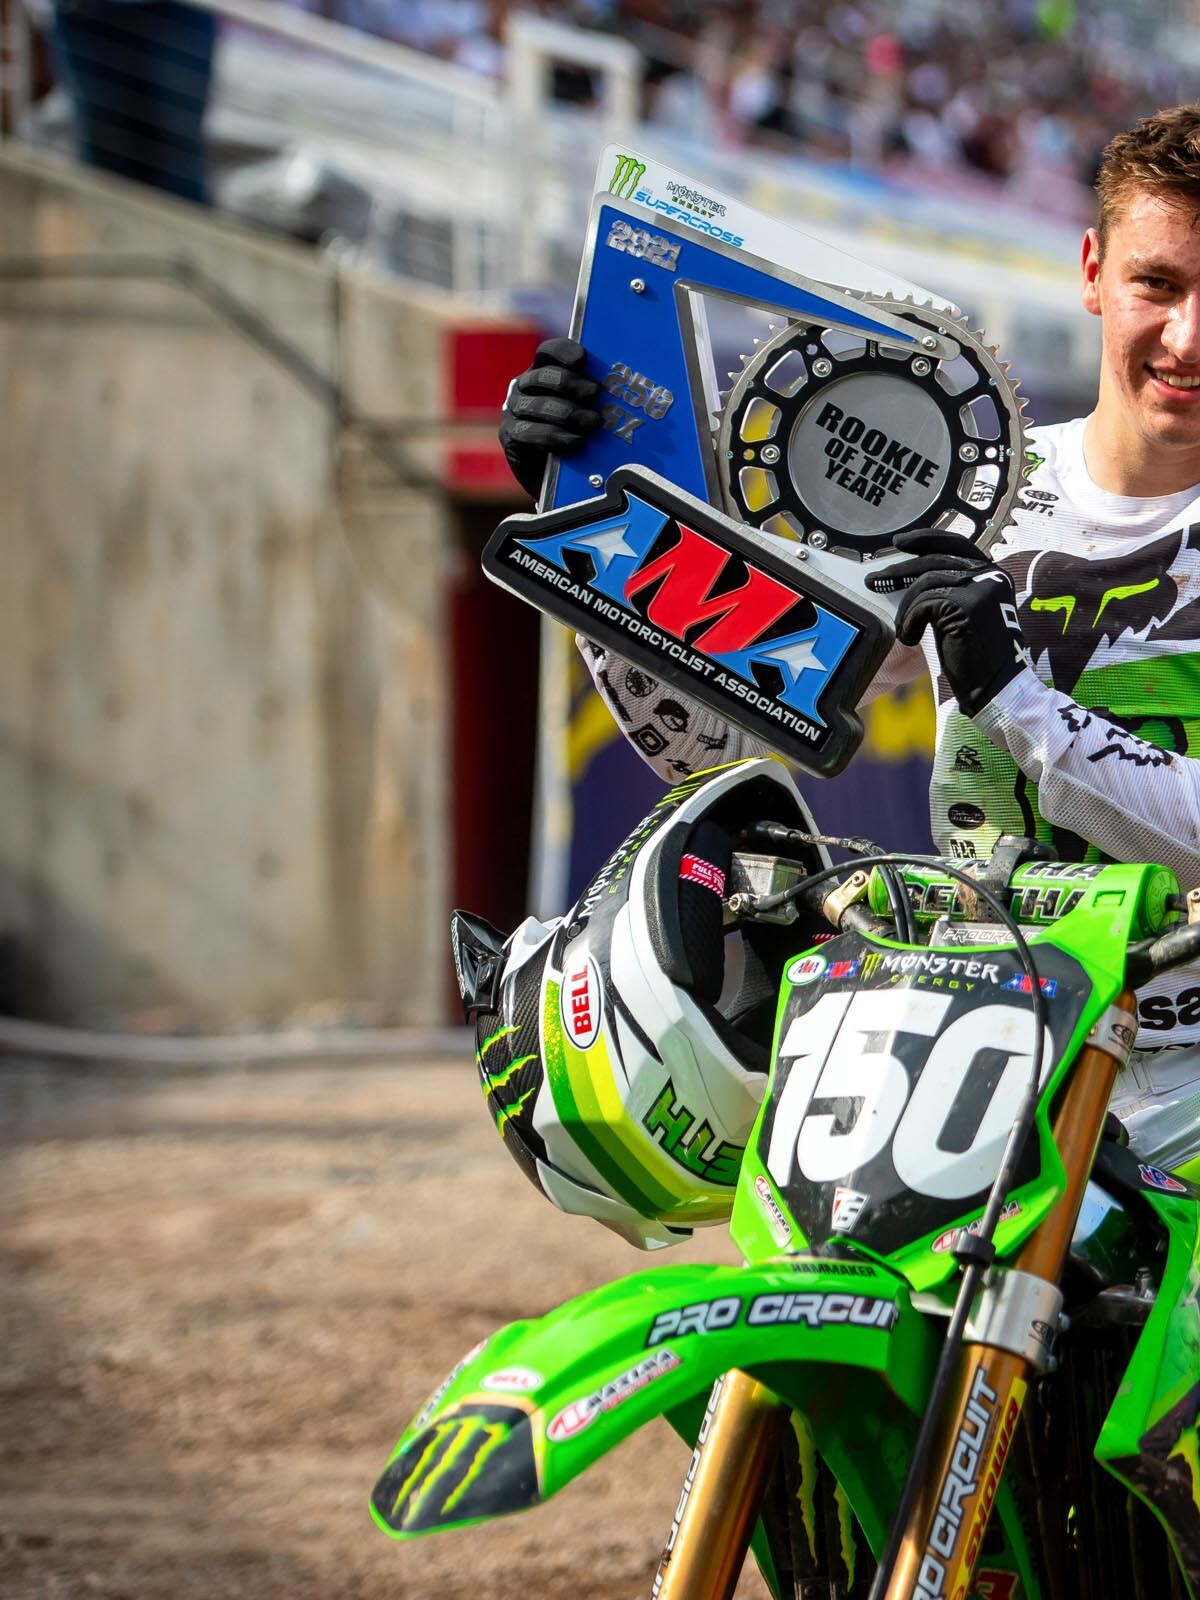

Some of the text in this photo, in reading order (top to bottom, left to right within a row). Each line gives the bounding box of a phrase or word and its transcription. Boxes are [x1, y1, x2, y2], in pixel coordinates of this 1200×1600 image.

[634, 191, 745, 248] SUPERCROSS
[666, 181, 727, 217] MONSTER
[671, 195, 716, 219] ENERGY
[605, 219, 682, 271] 2021
[603, 362, 674, 420] 250
[815, 402, 940, 489] ROOKIE
[824, 437, 907, 496] OF THE
[824, 458, 886, 507] YEAR
[513, 488, 861, 728] AMA
[508, 547, 822, 743] AMERICAN MOTORCYCLIST ASSOCIATION
[692, 863, 713, 877] PULL
[881, 953, 999, 984] MONSTER
[890, 974, 976, 993] ENERGY
[571, 964, 593, 1036] BELL
[766, 987, 1056, 1200] 150
[791, 1263, 877, 1278] HAMMAKER
[645, 1291, 899, 1347] PRO CIRCUI
[929, 1366, 998, 1561] CIRCUIT
[965, 1396, 1019, 1569] SHOWA
